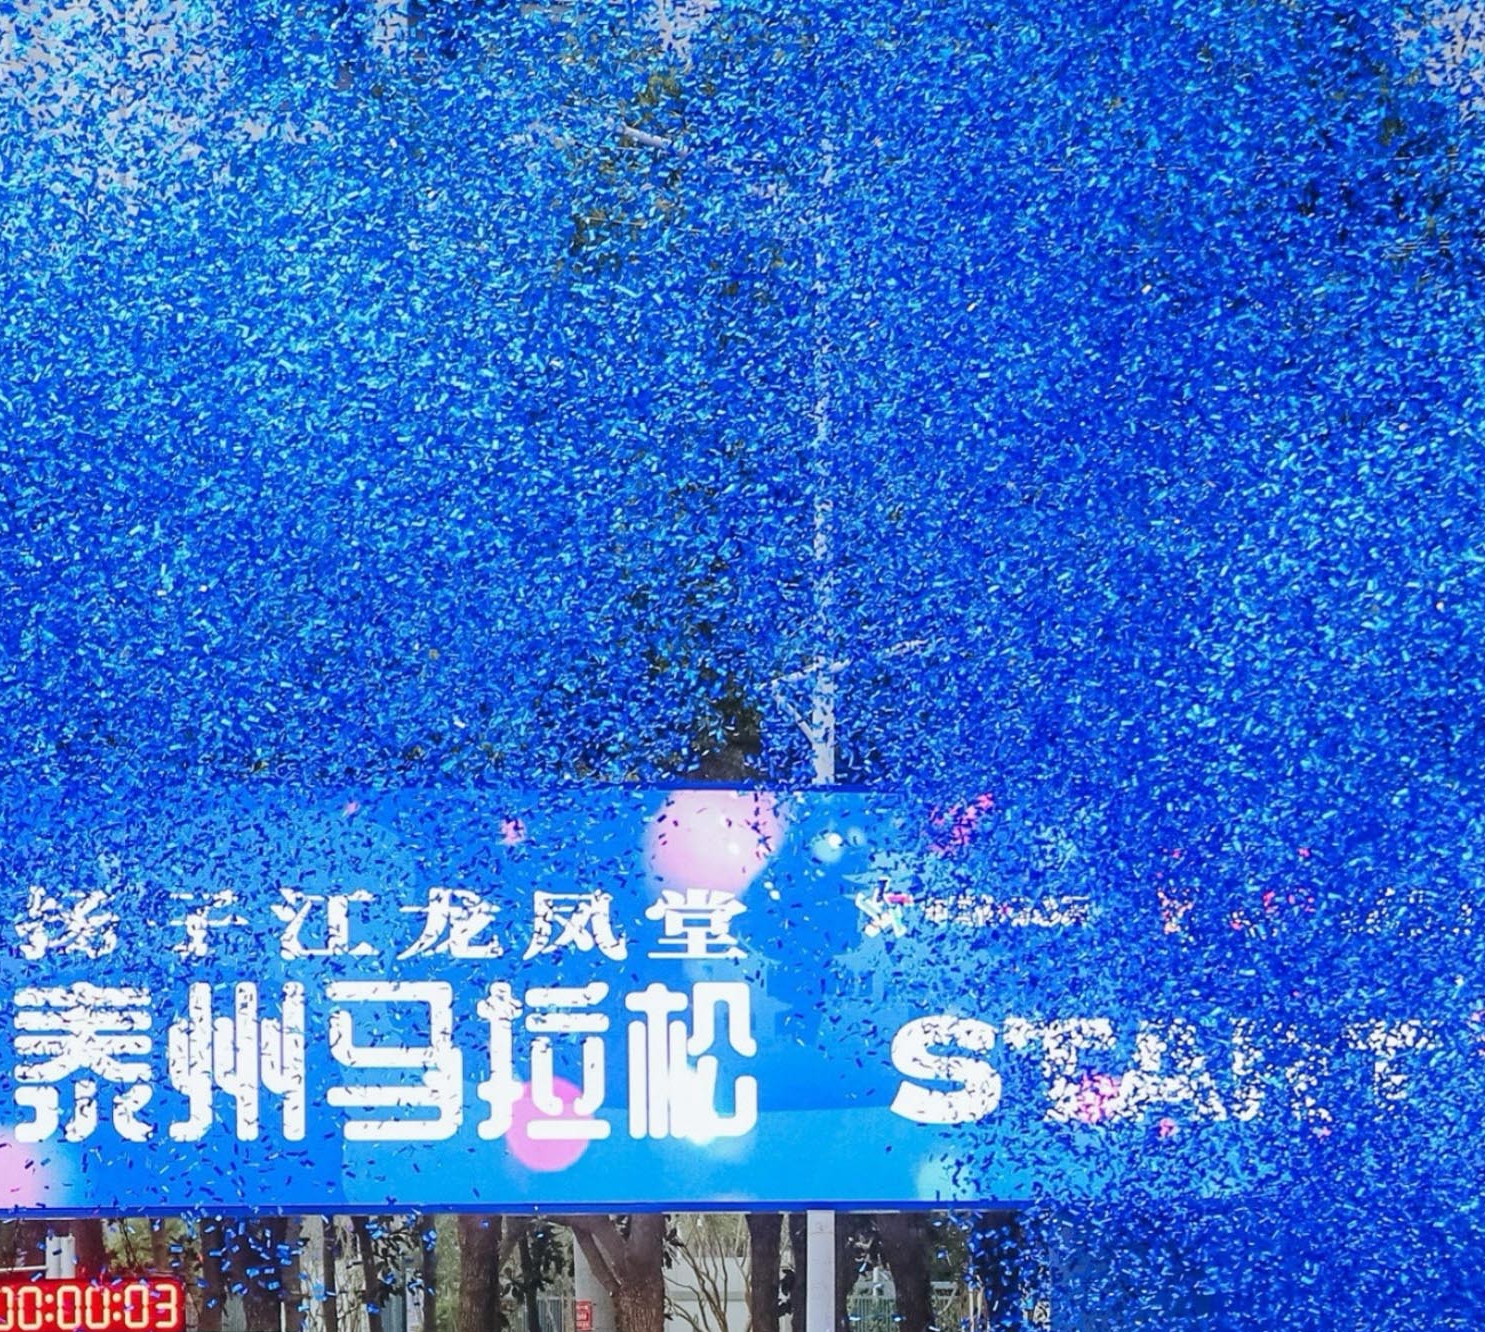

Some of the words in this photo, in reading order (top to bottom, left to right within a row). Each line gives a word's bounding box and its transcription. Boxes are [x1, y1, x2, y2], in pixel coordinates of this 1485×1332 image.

[13, 886, 750, 962] 扬子江龙凤堂
[13, 980, 759, 1143] 泰州马拉松
